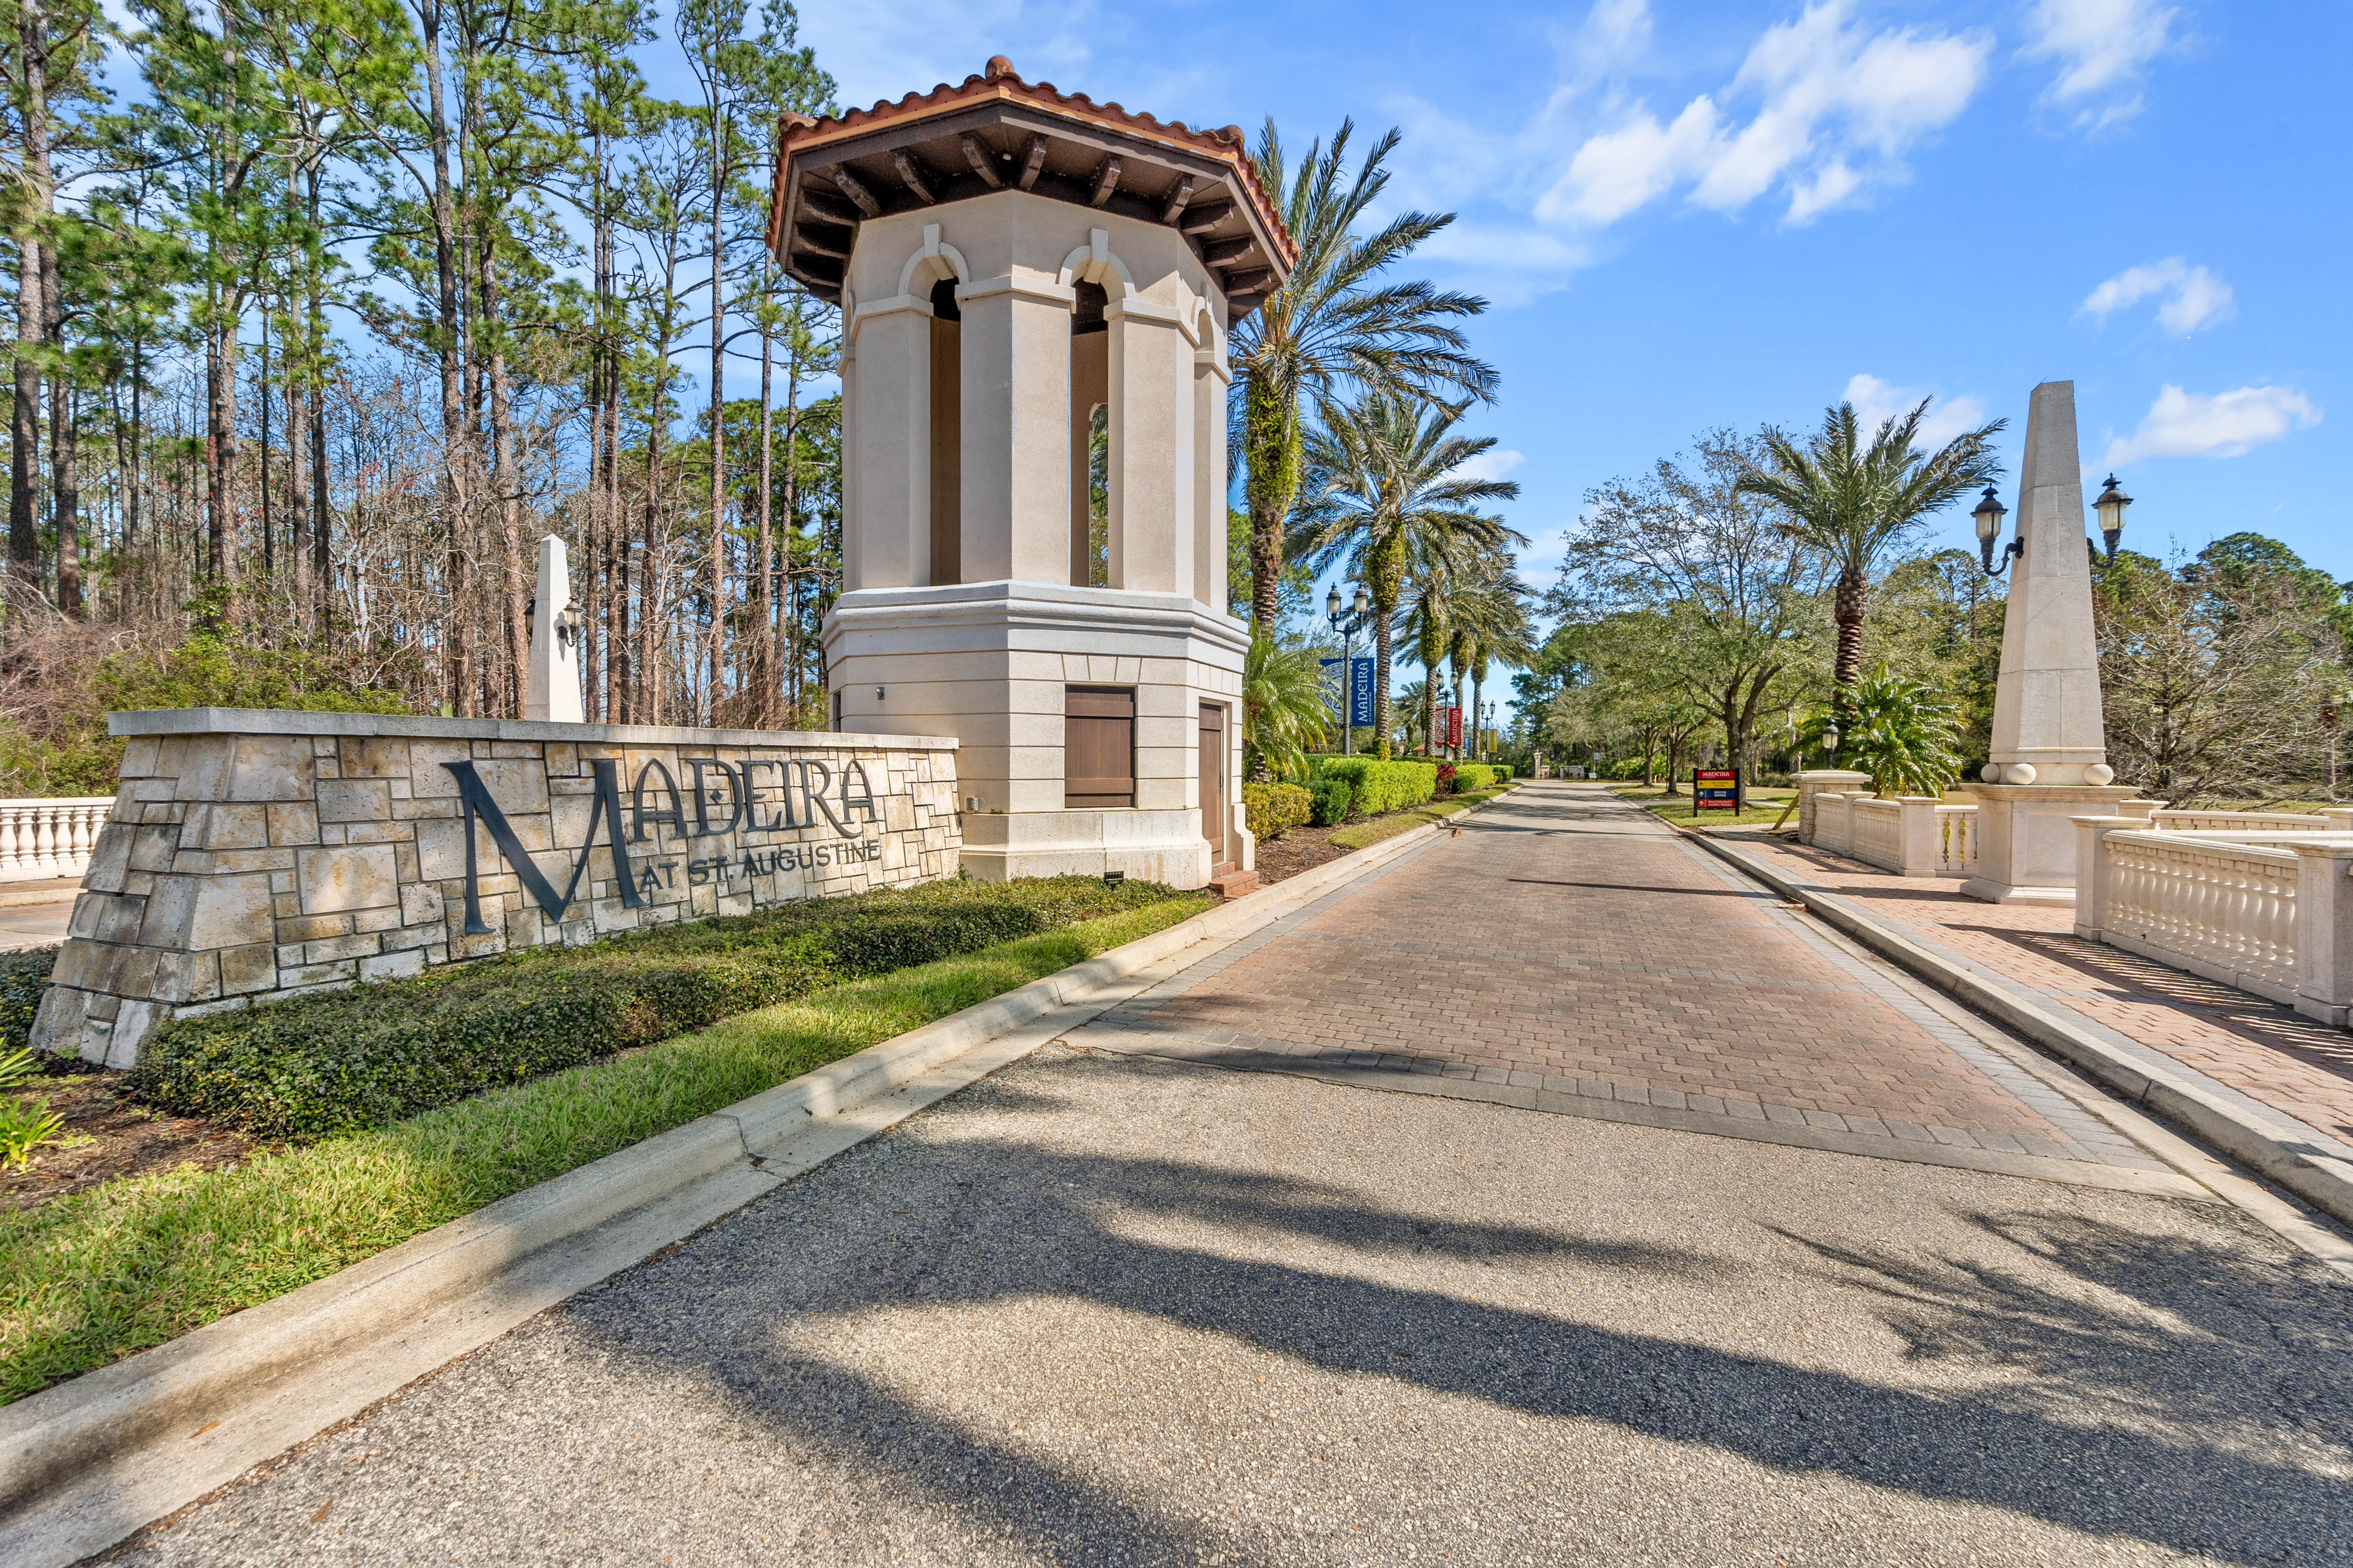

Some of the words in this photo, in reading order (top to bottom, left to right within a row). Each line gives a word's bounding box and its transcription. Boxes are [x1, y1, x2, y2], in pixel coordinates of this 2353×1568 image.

[1357, 662, 1369, 722] MADEIRA
[439, 758, 883, 935] MADEIRA
[640, 861, 679, 892] AT
[689, 856, 734, 885] ST.
[742, 839, 881, 878] AUGUSTINE
